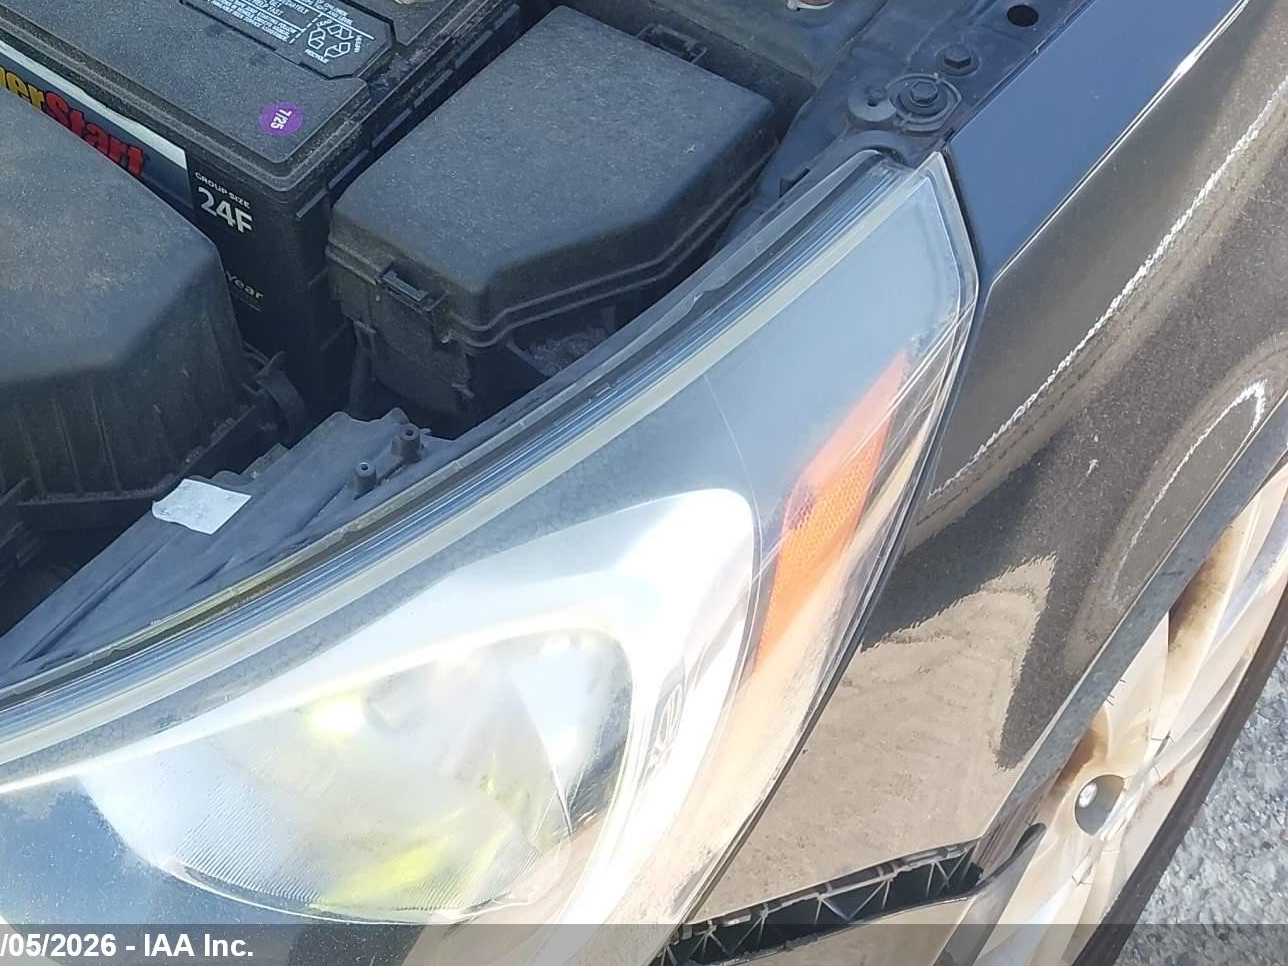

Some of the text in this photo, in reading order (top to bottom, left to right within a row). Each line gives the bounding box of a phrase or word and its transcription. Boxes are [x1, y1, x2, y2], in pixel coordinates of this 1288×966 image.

[267, 6, 283, 15] FAST
[195, 171, 251, 210] GROUP SIZE
[198, 186, 253, 234] 24F
